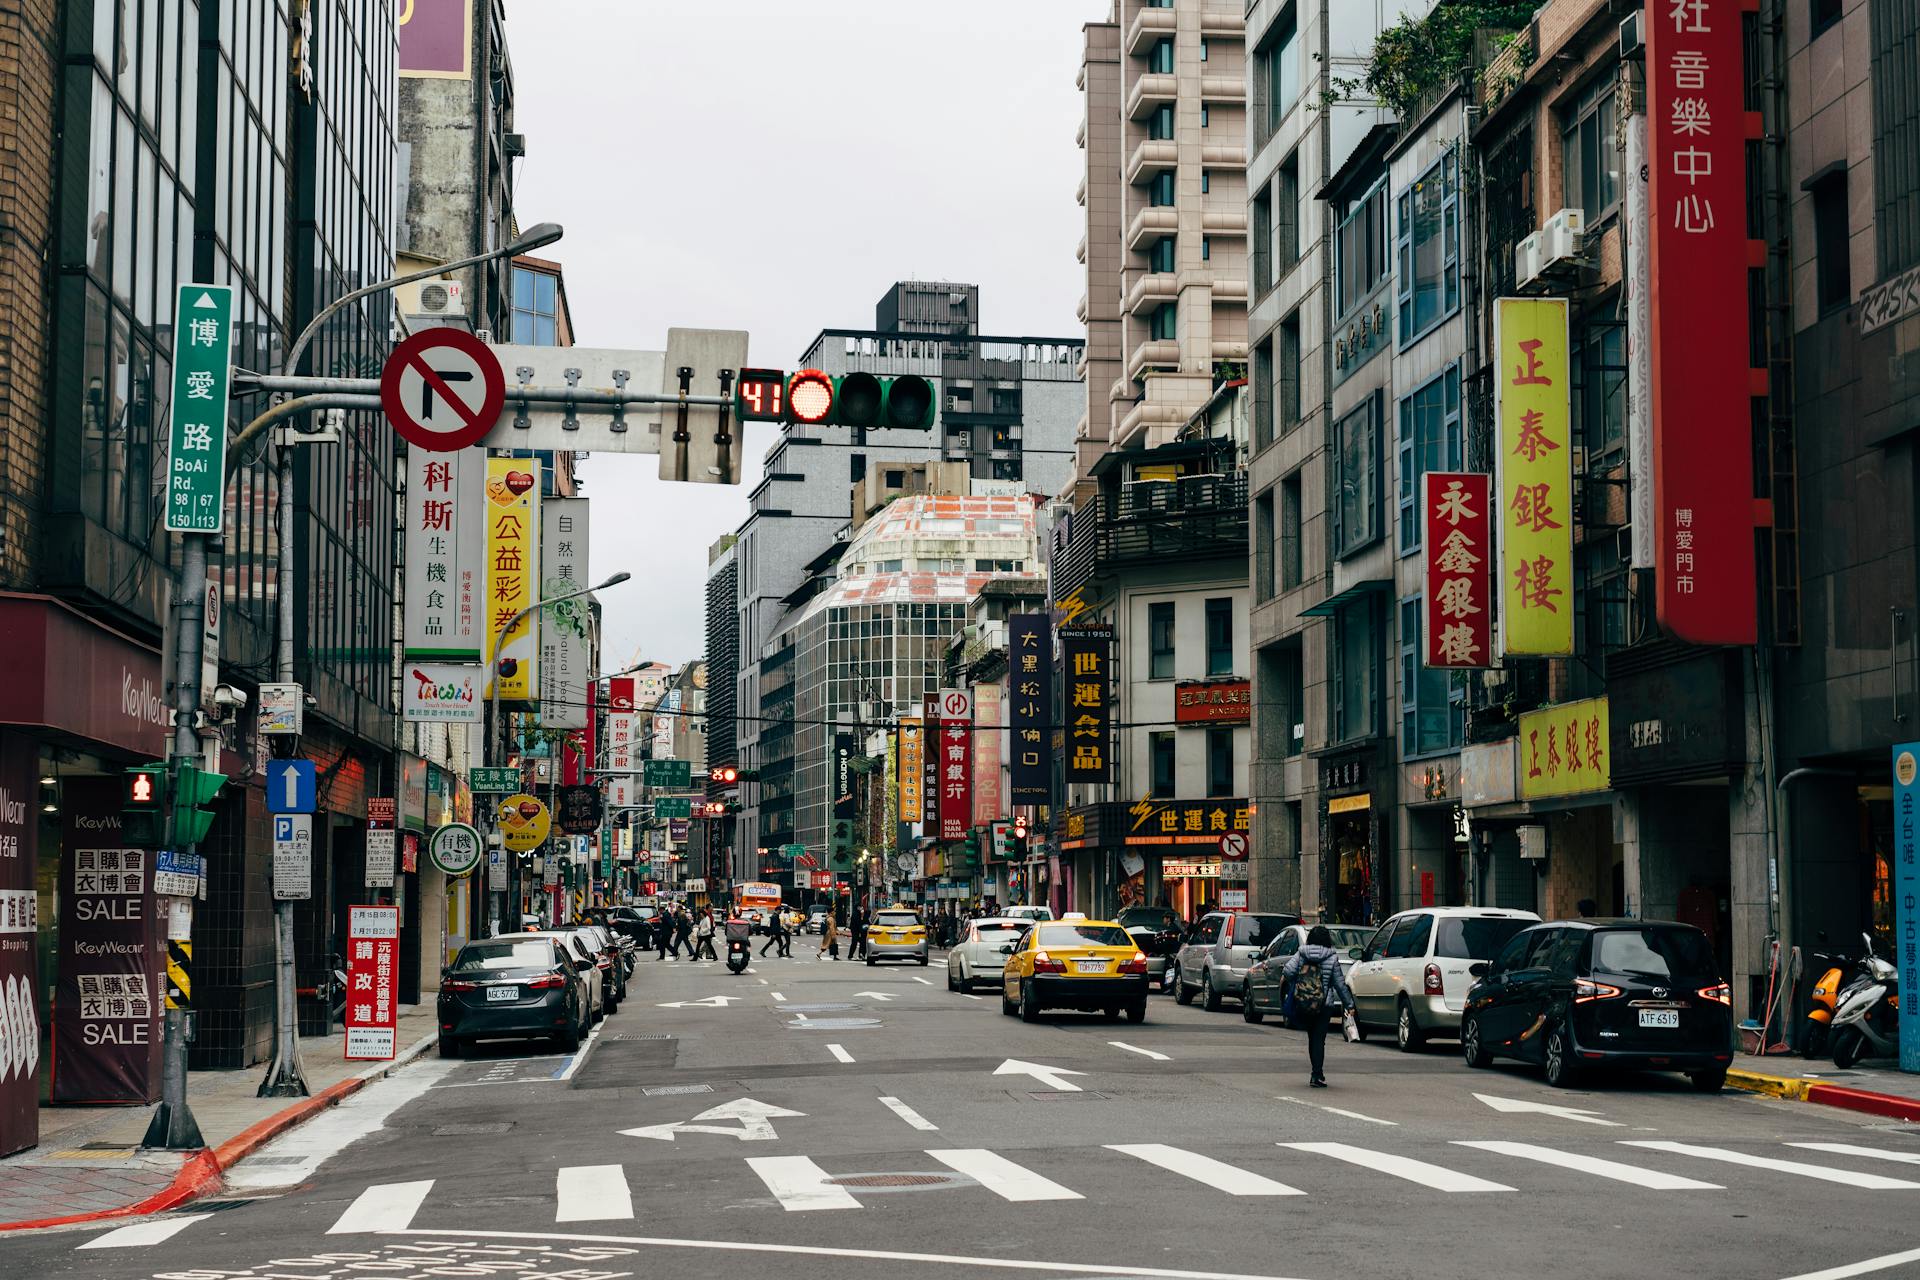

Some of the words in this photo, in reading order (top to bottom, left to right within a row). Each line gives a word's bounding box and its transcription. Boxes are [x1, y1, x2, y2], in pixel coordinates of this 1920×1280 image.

[181, 317, 220, 453] 博愛路
[742, 382, 781, 415] 41
[174, 457, 208, 473] BoAi
[1511, 338, 1563, 614] 正泰銀樓
[173, 476, 195, 491] Rd.
[175, 493, 189, 506] 98
[200, 494, 213, 507] 67
[171, 514, 190, 527] 150
[197, 515, 215, 528] 113
[421, 449, 454, 636] 科斯生機食品
[558, 514, 573, 580] 自然美
[1674, 508, 1695, 594] 博愛門市
[495, 514, 522, 634] 公益彩券
[1435, 481, 1481, 664] 永鑫銀樓
[1087, 630, 1112, 638] 1950
[560, 634, 571, 675] natural
[1020, 630, 1041, 766] 大黑松小倆口
[1072, 652, 1103, 770] 世運食品
[1527, 715, 1604, 780] 正泰銀樓
[947, 722, 966, 799] 華南銀行
[474, 771, 518, 782] 沅陵街
[475, 782, 505, 792] YuanLing
[507, 782, 515, 790] St
[1160, 807, 1249, 832] 世運食品
[441, 834, 471, 850] 有機
[76, 850, 143, 871] 員購會
[454, 853, 471, 863] 蔬果
[76, 872, 143, 893] 衣博會
[76, 899, 142, 921] SALE
[75, 940, 145, 956] KeyWear
[79, 975, 146, 997] 員購會
[354, 941, 374, 1022] 請改道
[375, 941, 392, 1023] 沅陵街交通管制
[84, 996, 150, 1018] 衣博會
[83, 1022, 149, 1045] SALE
